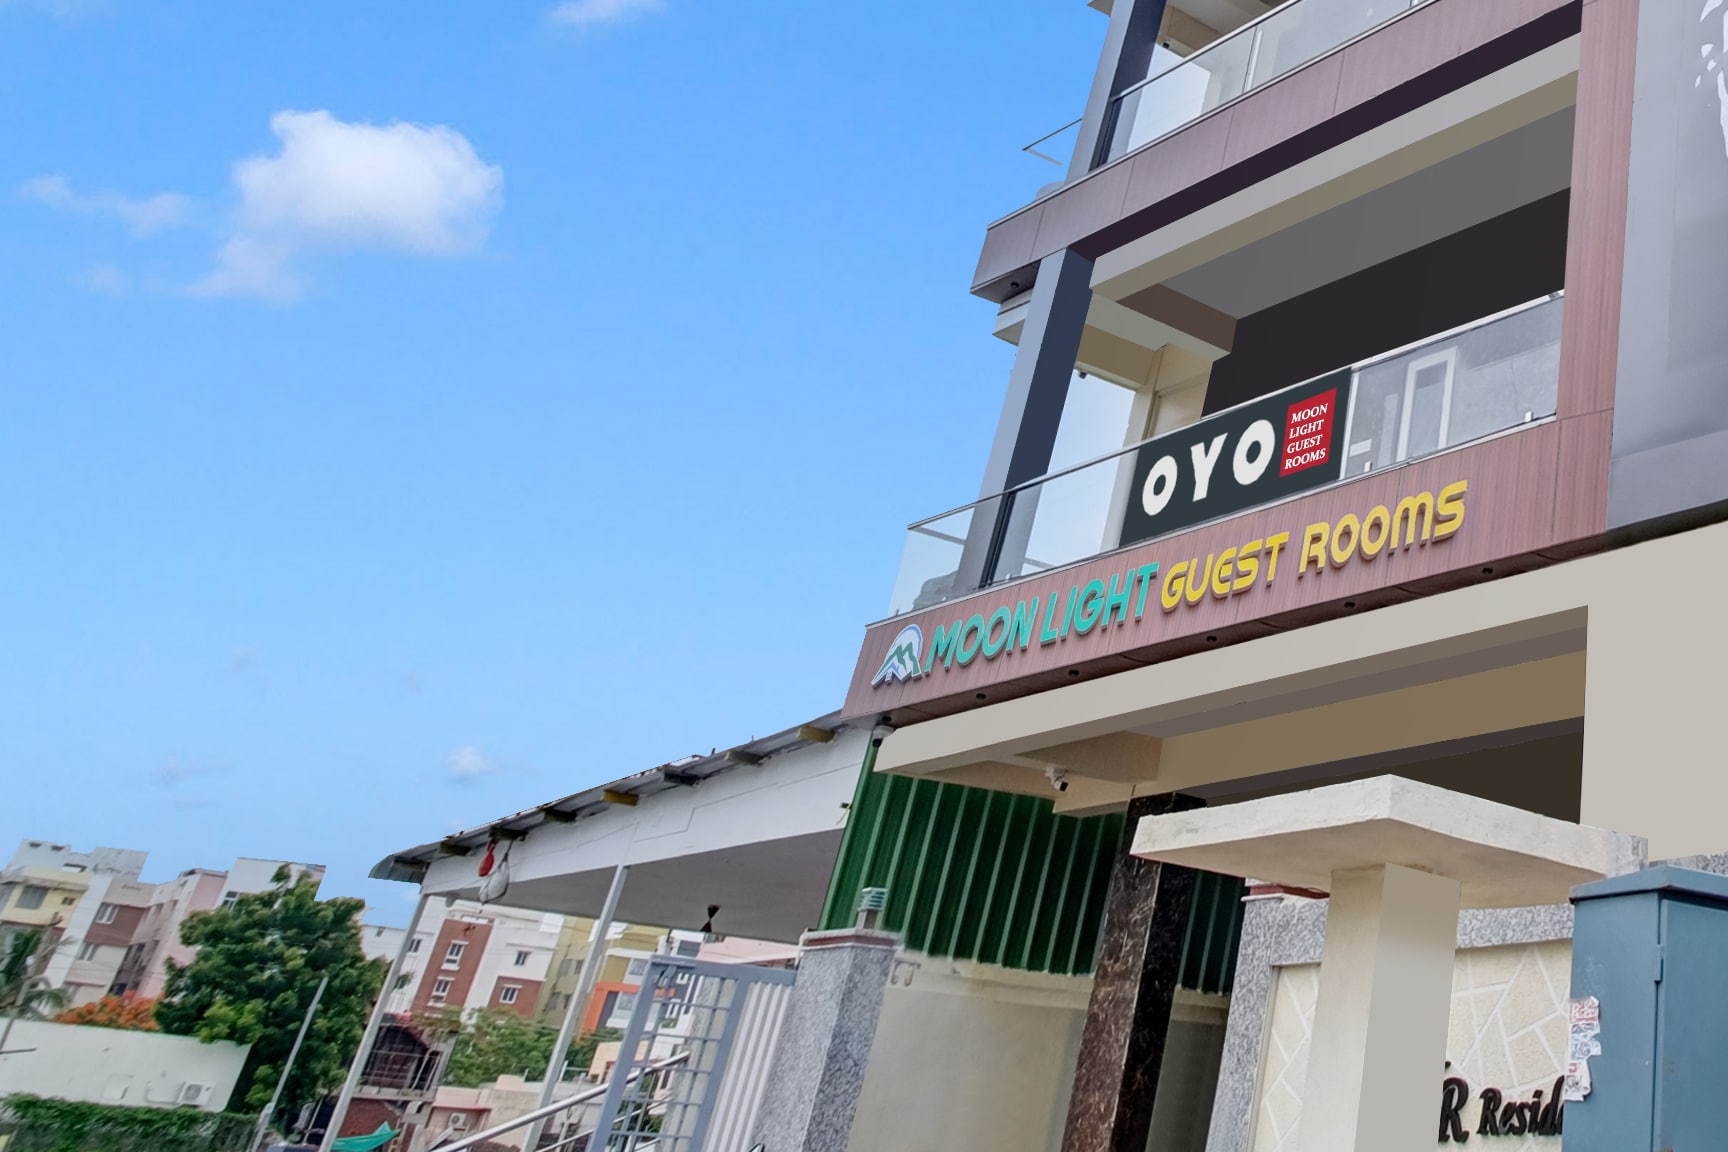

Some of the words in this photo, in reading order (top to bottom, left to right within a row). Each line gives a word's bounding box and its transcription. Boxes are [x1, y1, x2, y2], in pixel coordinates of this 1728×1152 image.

[1291, 403, 1329, 424] MOON
[1289, 419, 1325, 439] LIGHT
[1286, 434, 1323, 454] GUEST
[1142, 419, 1276, 516] OYO
[1284, 448, 1327, 470] ROOMS
[924, 597, 1039, 677] MOON
[1040, 562, 1160, 647] LIGHT
[1160, 531, 1290, 614] GUEST
[1297, 480, 1468, 580] ROOMS
[1476, 1075, 1564, 1136] Resid
